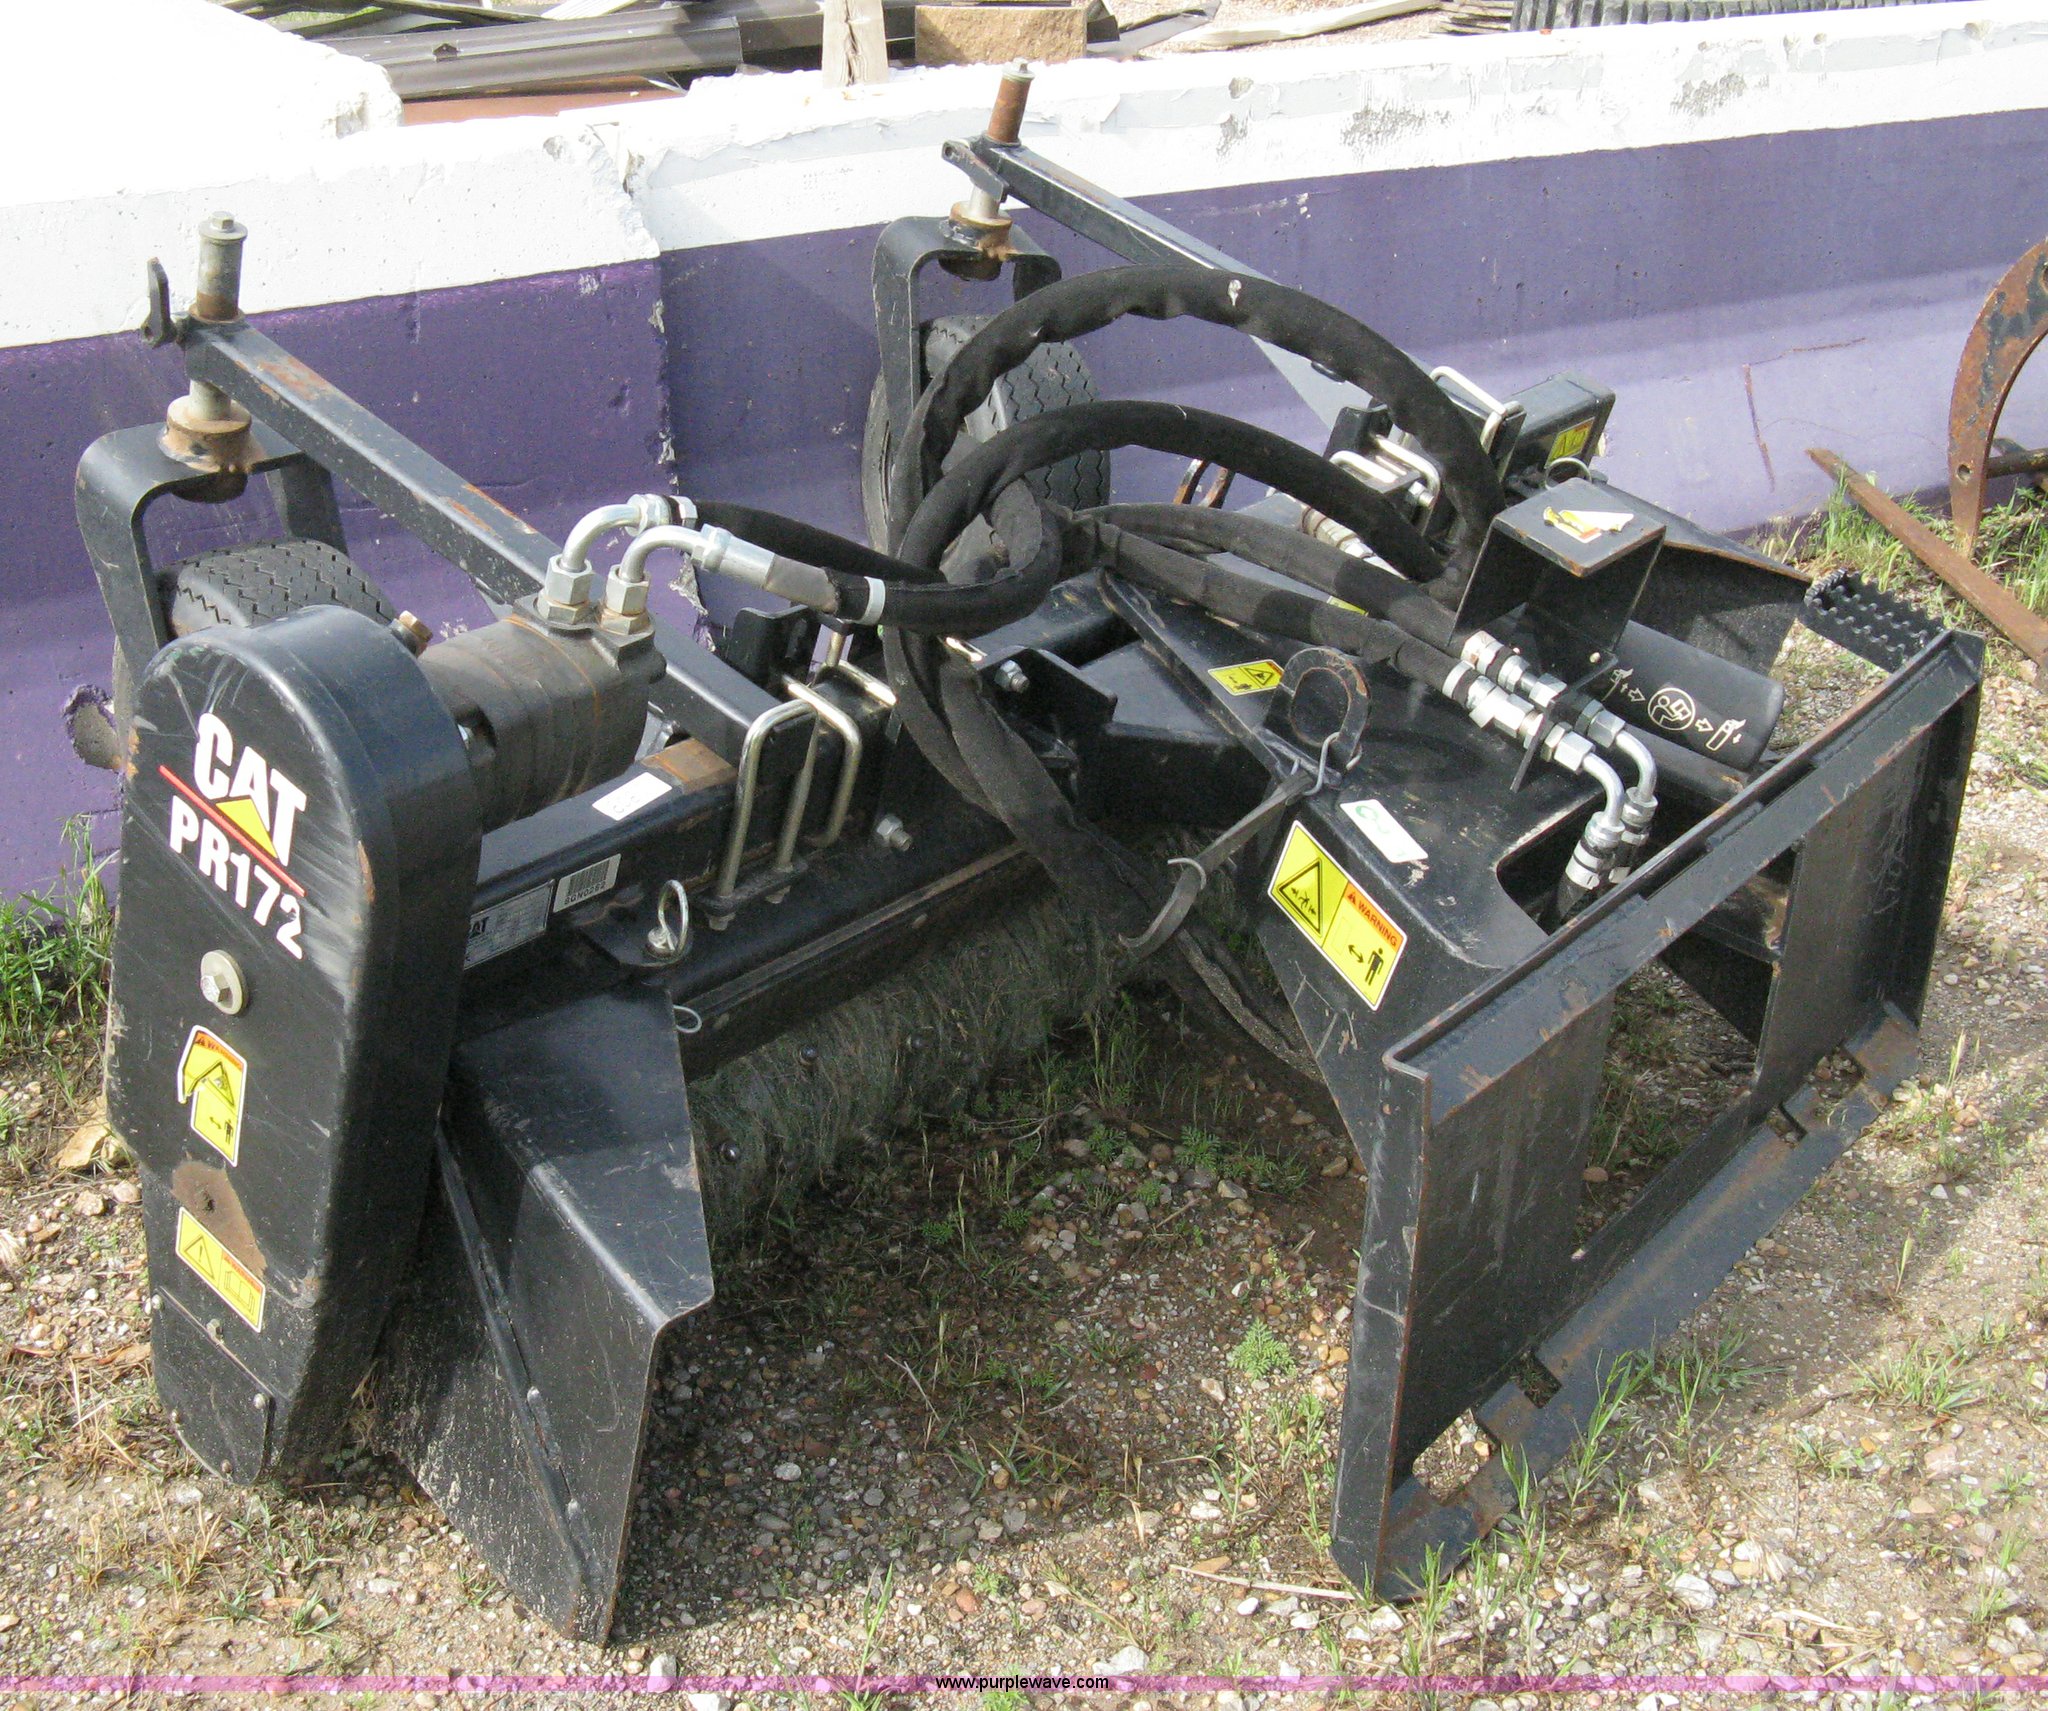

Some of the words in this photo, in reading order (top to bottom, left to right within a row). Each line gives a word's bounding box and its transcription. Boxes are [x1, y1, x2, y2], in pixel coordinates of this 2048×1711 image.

[194, 712, 307, 867] CAT
[169, 795, 303, 960] PR172
[1359, 902, 1398, 947] WARNING
